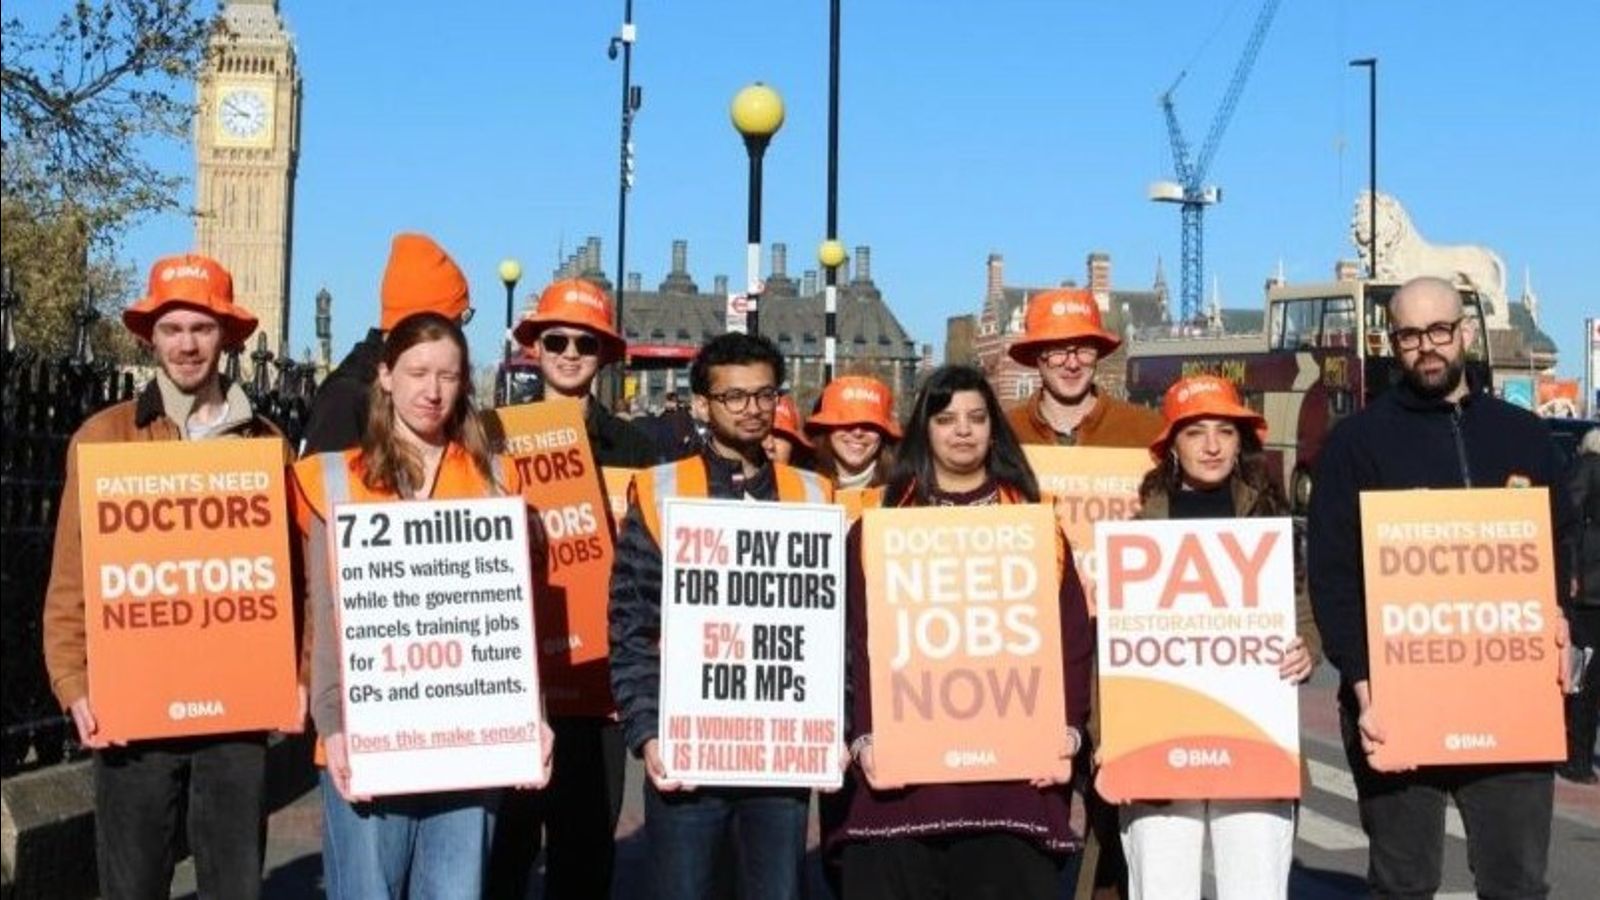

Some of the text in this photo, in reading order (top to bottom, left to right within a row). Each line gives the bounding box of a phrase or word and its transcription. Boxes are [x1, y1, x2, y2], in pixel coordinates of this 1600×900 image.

[177, 266, 209, 282] BMA
[535, 428, 578, 449] NEED
[517, 448, 585, 486] TORS
[96, 471, 269, 496] PATIENTS NEED
[98, 495, 272, 534] DOCTORS
[540, 502, 598, 539] ORS
[1063, 495, 1142, 524] TORS
[337, 509, 513, 549] 7.2 million
[884, 524, 1035, 556] DOCTORS
[1377, 520, 1538, 540] PATIENTS NEED
[550, 536, 604, 573] JOBS
[675, 526, 832, 569] 21% PAY CUT
[1380, 543, 1539, 575] DOCTORS
[100, 556, 277, 599] DOCTORS
[342, 556, 514, 580] on NHS waiting lists,
[886, 554, 1038, 604] NEED
[1106, 531, 1281, 609] PAY
[343, 584, 523, 610] while the government
[674, 568, 836, 610] FOR DOCTORS
[102, 595, 278, 630] NEED JOBS
[345, 614, 519, 640] cancels training jobs
[1108, 613, 1285, 632] RESTORATION FOR
[1382, 600, 1544, 635] DOCTORS
[703, 622, 805, 661] 5% RISE
[890, 604, 1042, 670] JOBS
[1109, 635, 1284, 667] DOCTORS
[1385, 636, 1545, 666] NEED JOBS
[349, 640, 522, 678] for 1,000 future
[349, 676, 527, 704] GPs and consultants.
[701, 663, 806, 702] FOR MPs
[891, 666, 1041, 722] NOW
[186, 701, 224, 718] BMA
[350, 722, 536, 751] Does this make sense?
[669, 715, 835, 744] NO WONDER THE NHS
[1461, 734, 1496, 748] BMA
[673, 743, 828, 774] IS FALLING APART
[961, 750, 997, 766] BMA
[1189, 749, 1230, 766] BMA
